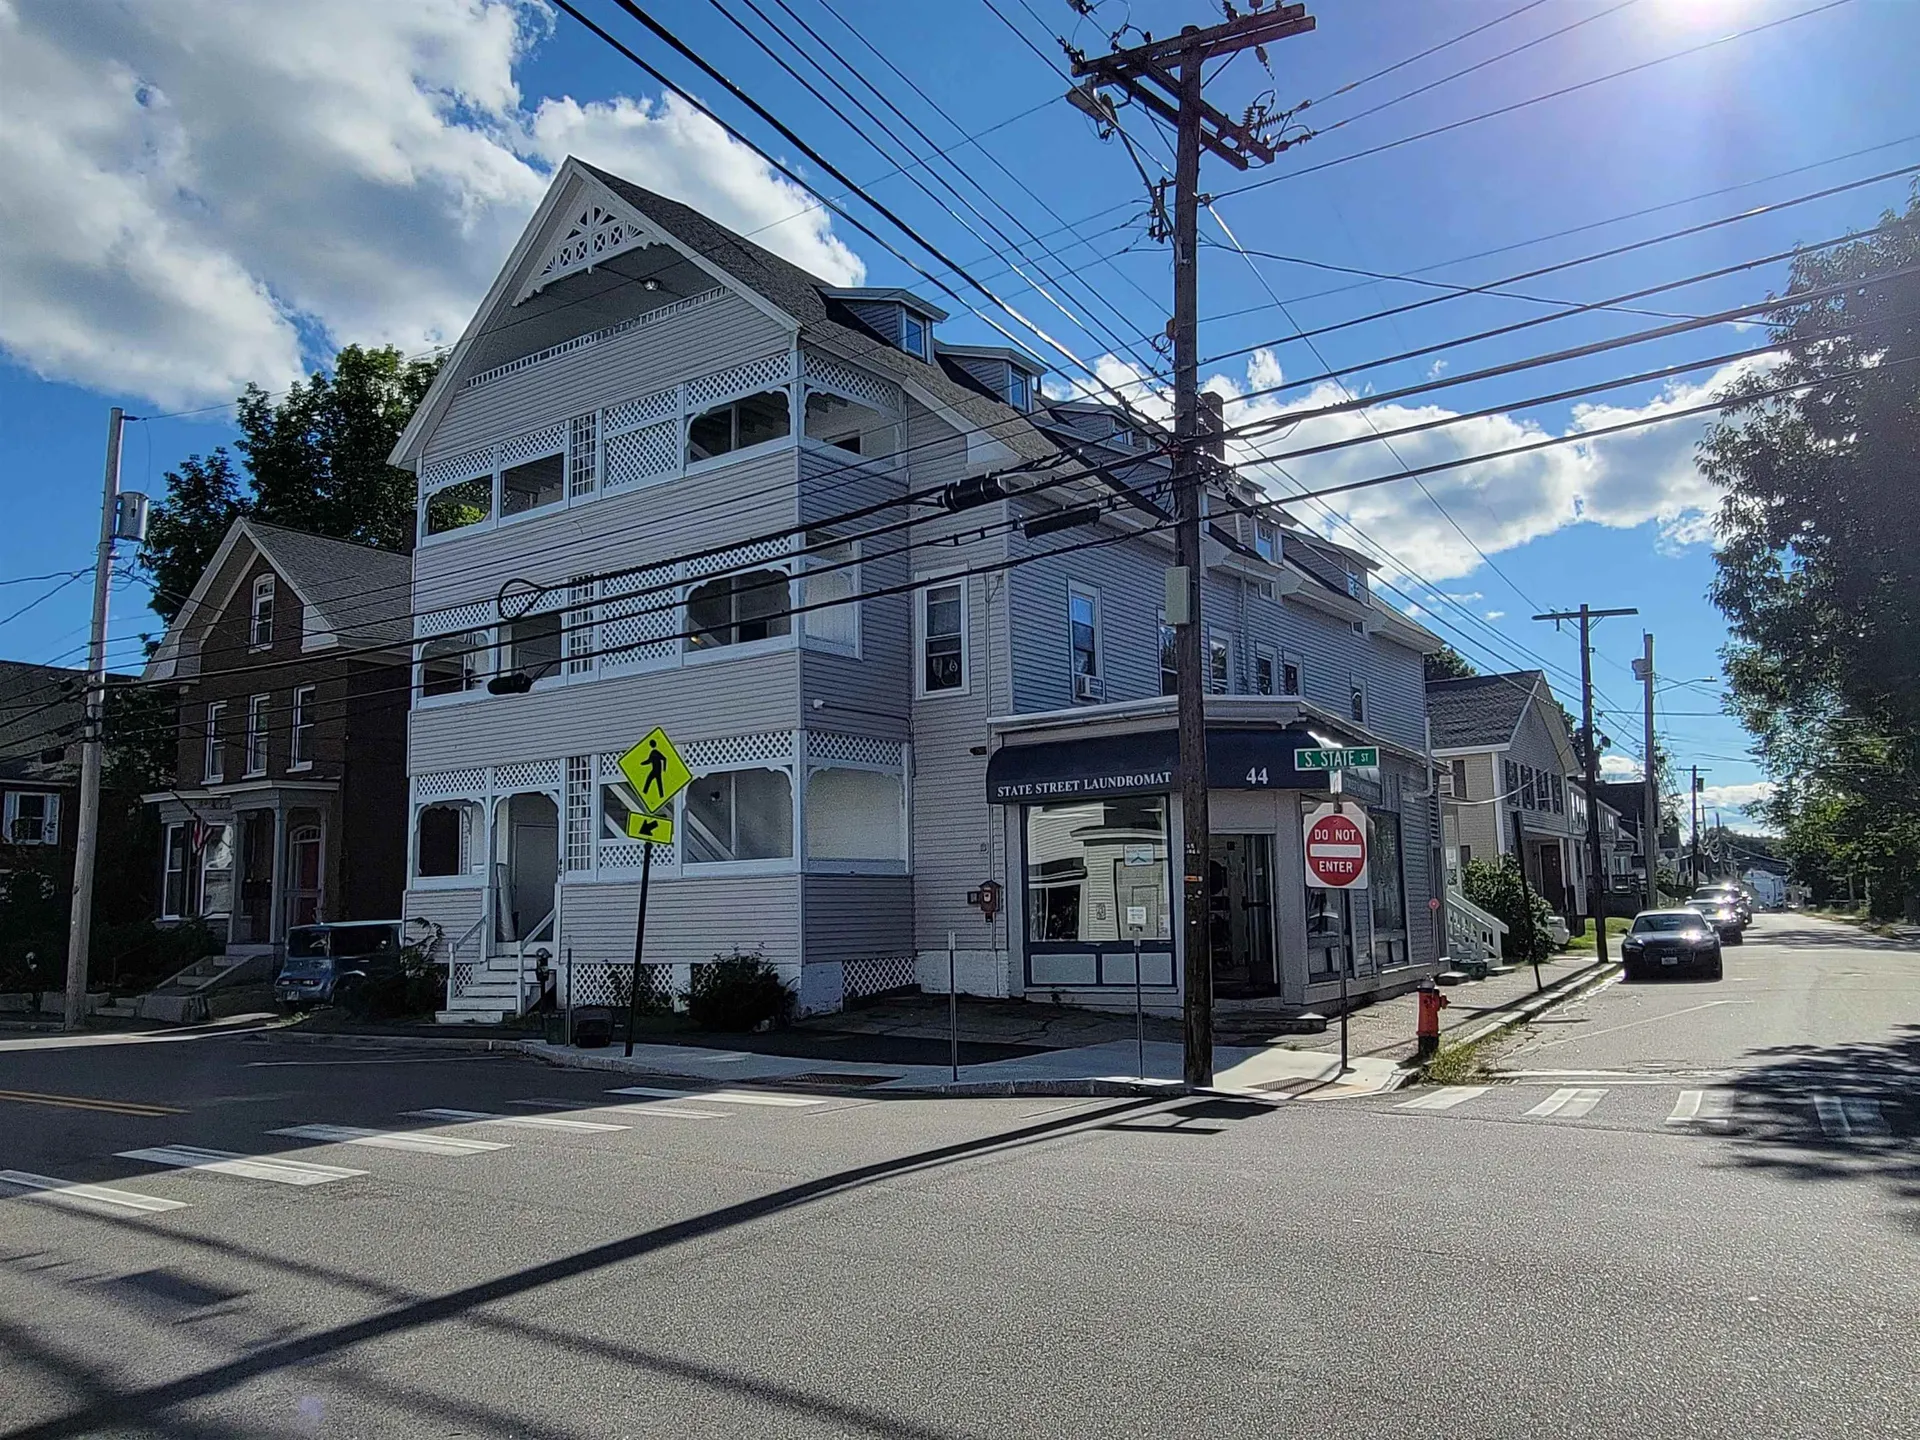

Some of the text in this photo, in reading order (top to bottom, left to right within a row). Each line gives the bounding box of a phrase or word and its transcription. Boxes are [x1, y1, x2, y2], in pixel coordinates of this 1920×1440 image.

[1304, 750, 1369, 768] S. STATE ST
[997, 771, 1172, 797] STATE STREET LAUNDROMAT
[1246, 767, 1269, 785] 44
[1314, 829, 1356, 841] DO NOT
[1319, 860, 1353, 873] ENTER
